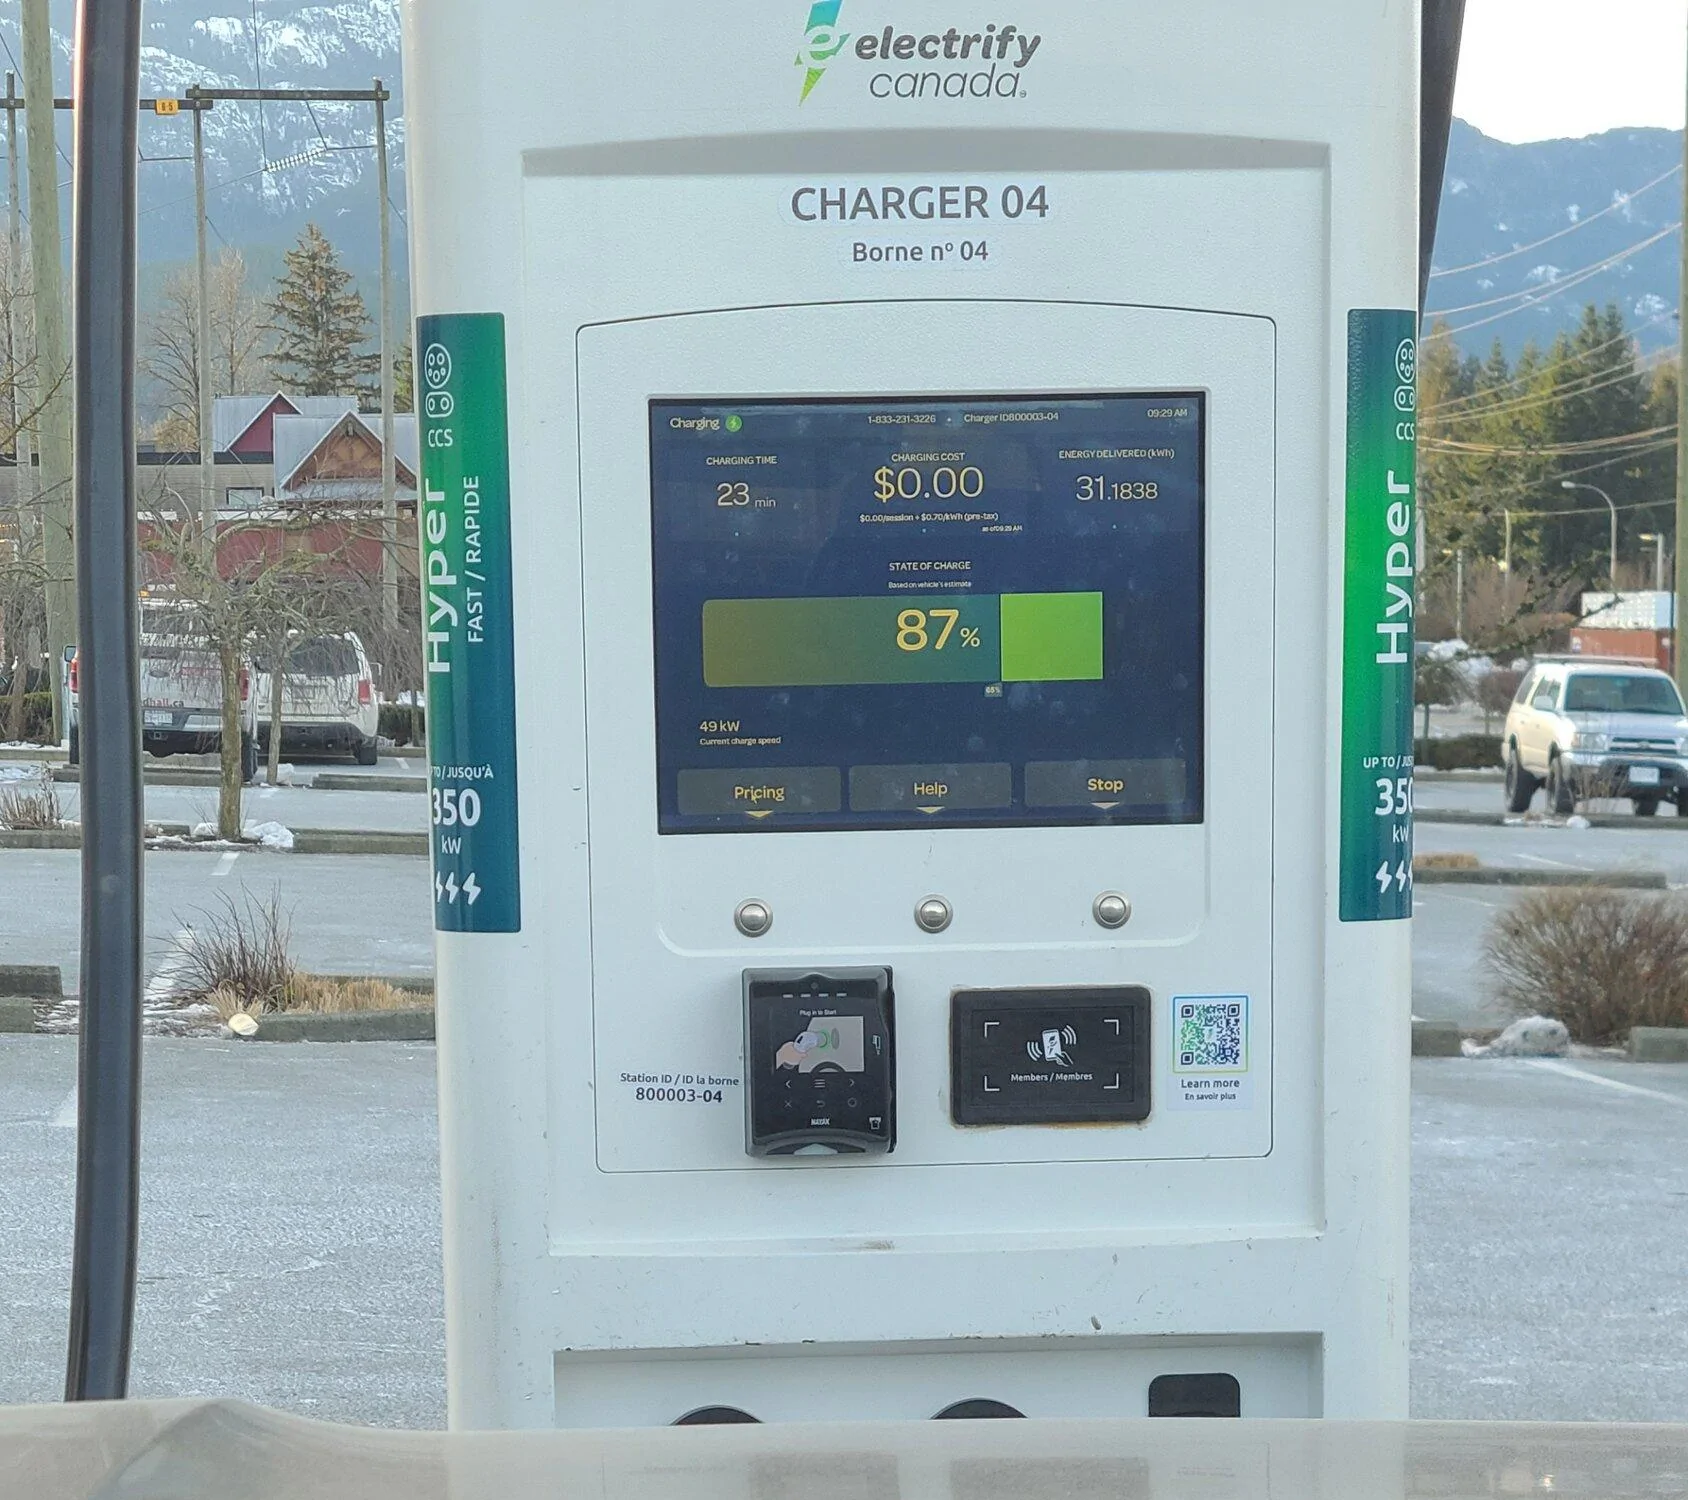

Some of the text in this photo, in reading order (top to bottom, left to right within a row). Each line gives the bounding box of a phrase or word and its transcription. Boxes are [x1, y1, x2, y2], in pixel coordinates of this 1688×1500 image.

[854, 24, 1041, 68] electrify
[791, 185, 1049, 221] CHARGER 04
[853, 242, 923, 262] Borne
[960, 241, 988, 261] 04
[868, 415, 936, 424] 1-833-231-3226
[964, 414, 999, 424] Charger
[1147, 409, 1188, 418] 09:29 AM
[670, 417, 720, 430] Charging
[428, 429, 453, 447] CCS
[1396, 422, 1415, 441] CCS
[706, 456, 777, 466] CHARGING TIME
[891, 453, 966, 462] CHARGING COST
[1059, 448, 1175, 459] ENERGY DELIVERED (kWh)
[873, 465, 985, 503] $0.00
[1075, 475, 1158, 501] 31.1838
[717, 482, 776, 508] 23 min
[463, 475, 486, 643] FAST / RAPIDE
[889, 561, 971, 571] STATE OF CHARGE
[1375, 470, 1413, 664] Hyper
[425, 478, 458, 673] Hyper
[896, 608, 981, 651] 87%
[700, 720, 740, 732] 49 kW
[700, 736, 781, 746] Current charge speed
[1363, 757, 1379, 768] UP
[1381, 756, 1395, 768] TO
[447, 764, 494, 781] JUSQU'À
[913, 782, 948, 797] Help
[1087, 778, 1124, 793] Stop
[734, 785, 785, 802] Pricing
[1392, 823, 1409, 843] kW
[441, 835, 462, 855] kW
[620, 1072, 739, 1085] Station ID / ID la borne
[1010, 1073, 1048, 1082] Members
[1055, 1072, 1093, 1080] Membres
[1181, 1079, 1240, 1088] Learn more
[636, 1087, 723, 1102] 800003-04
[1220, 1092, 1236, 1101] plus
